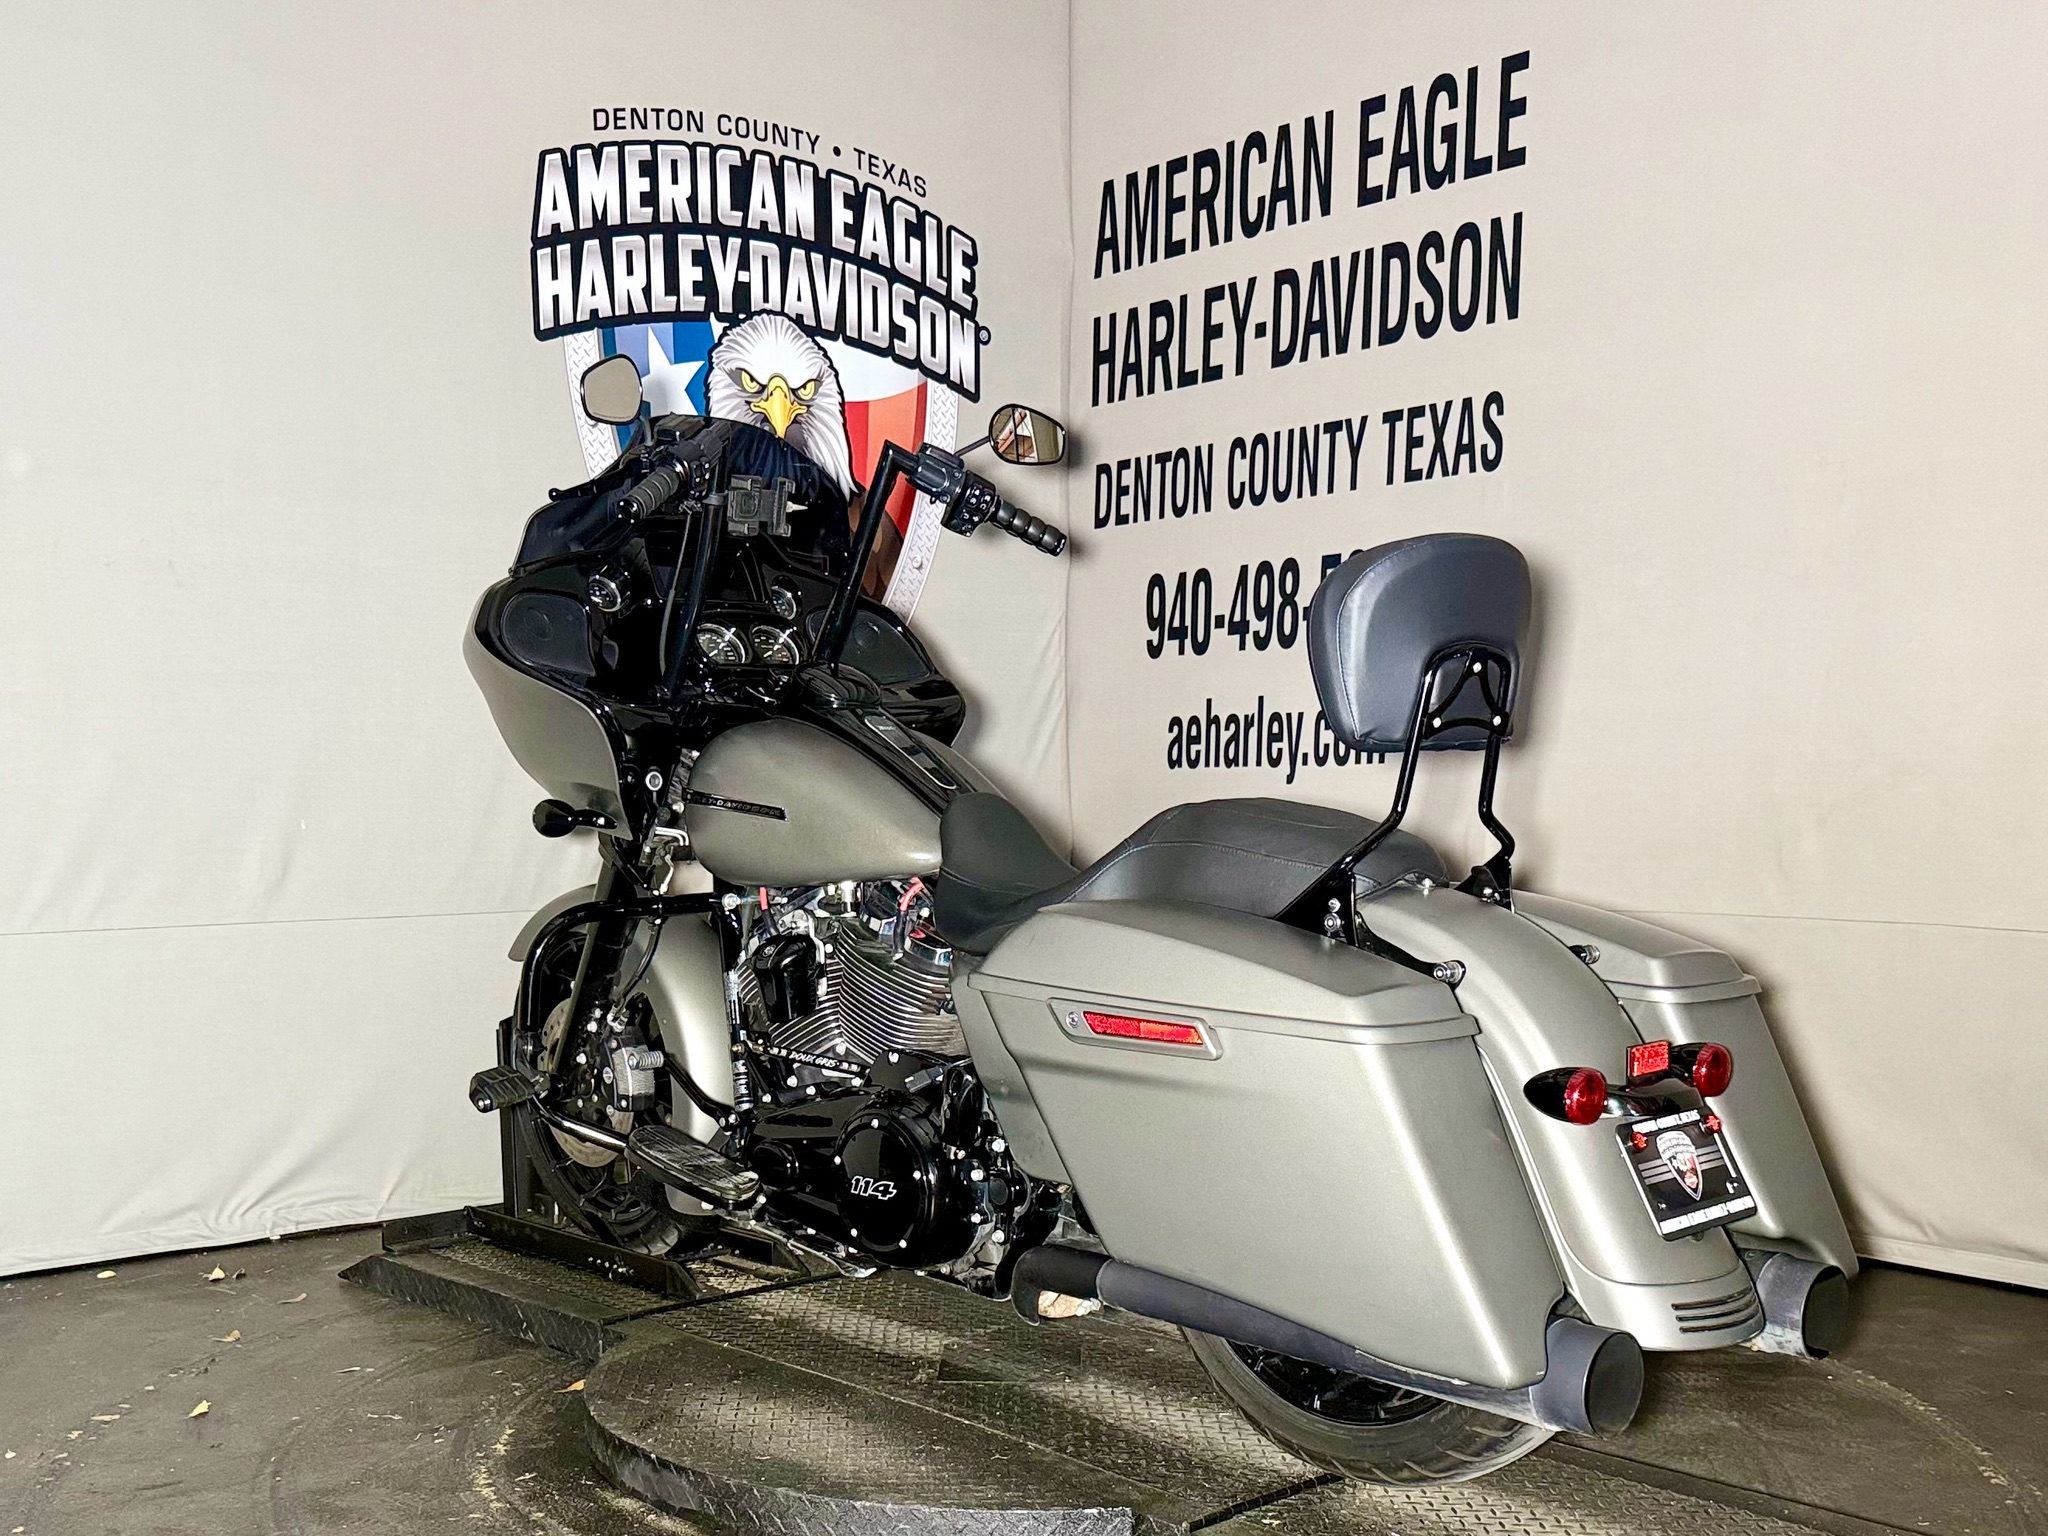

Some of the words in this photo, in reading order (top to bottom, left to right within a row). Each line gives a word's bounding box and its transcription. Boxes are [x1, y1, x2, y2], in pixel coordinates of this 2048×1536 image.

[535, 142, 817, 243] AMERICAN
[829, 172, 976, 313] EAGLE
[591, 107, 704, 132] DENTON
[716, 113, 821, 155] COUNTY
[853, 147, 928, 199] TEXAS
[1093, 109, 1335, 280] AMERICAN
[1356, 49, 1531, 209] EAGLE
[535, 232, 978, 396] HARLEY-DAVIDSON
[1090, 210, 1524, 409] HARLEY-DAVIDSON
[1093, 442, 1215, 531] DENTON
[1226, 414, 1369, 511] COUNTY
[1381, 389, 1505, 487] TEXAS
[1166, 694, 1386, 786] aeharley.c
[850, 1175, 897, 1201] 114
